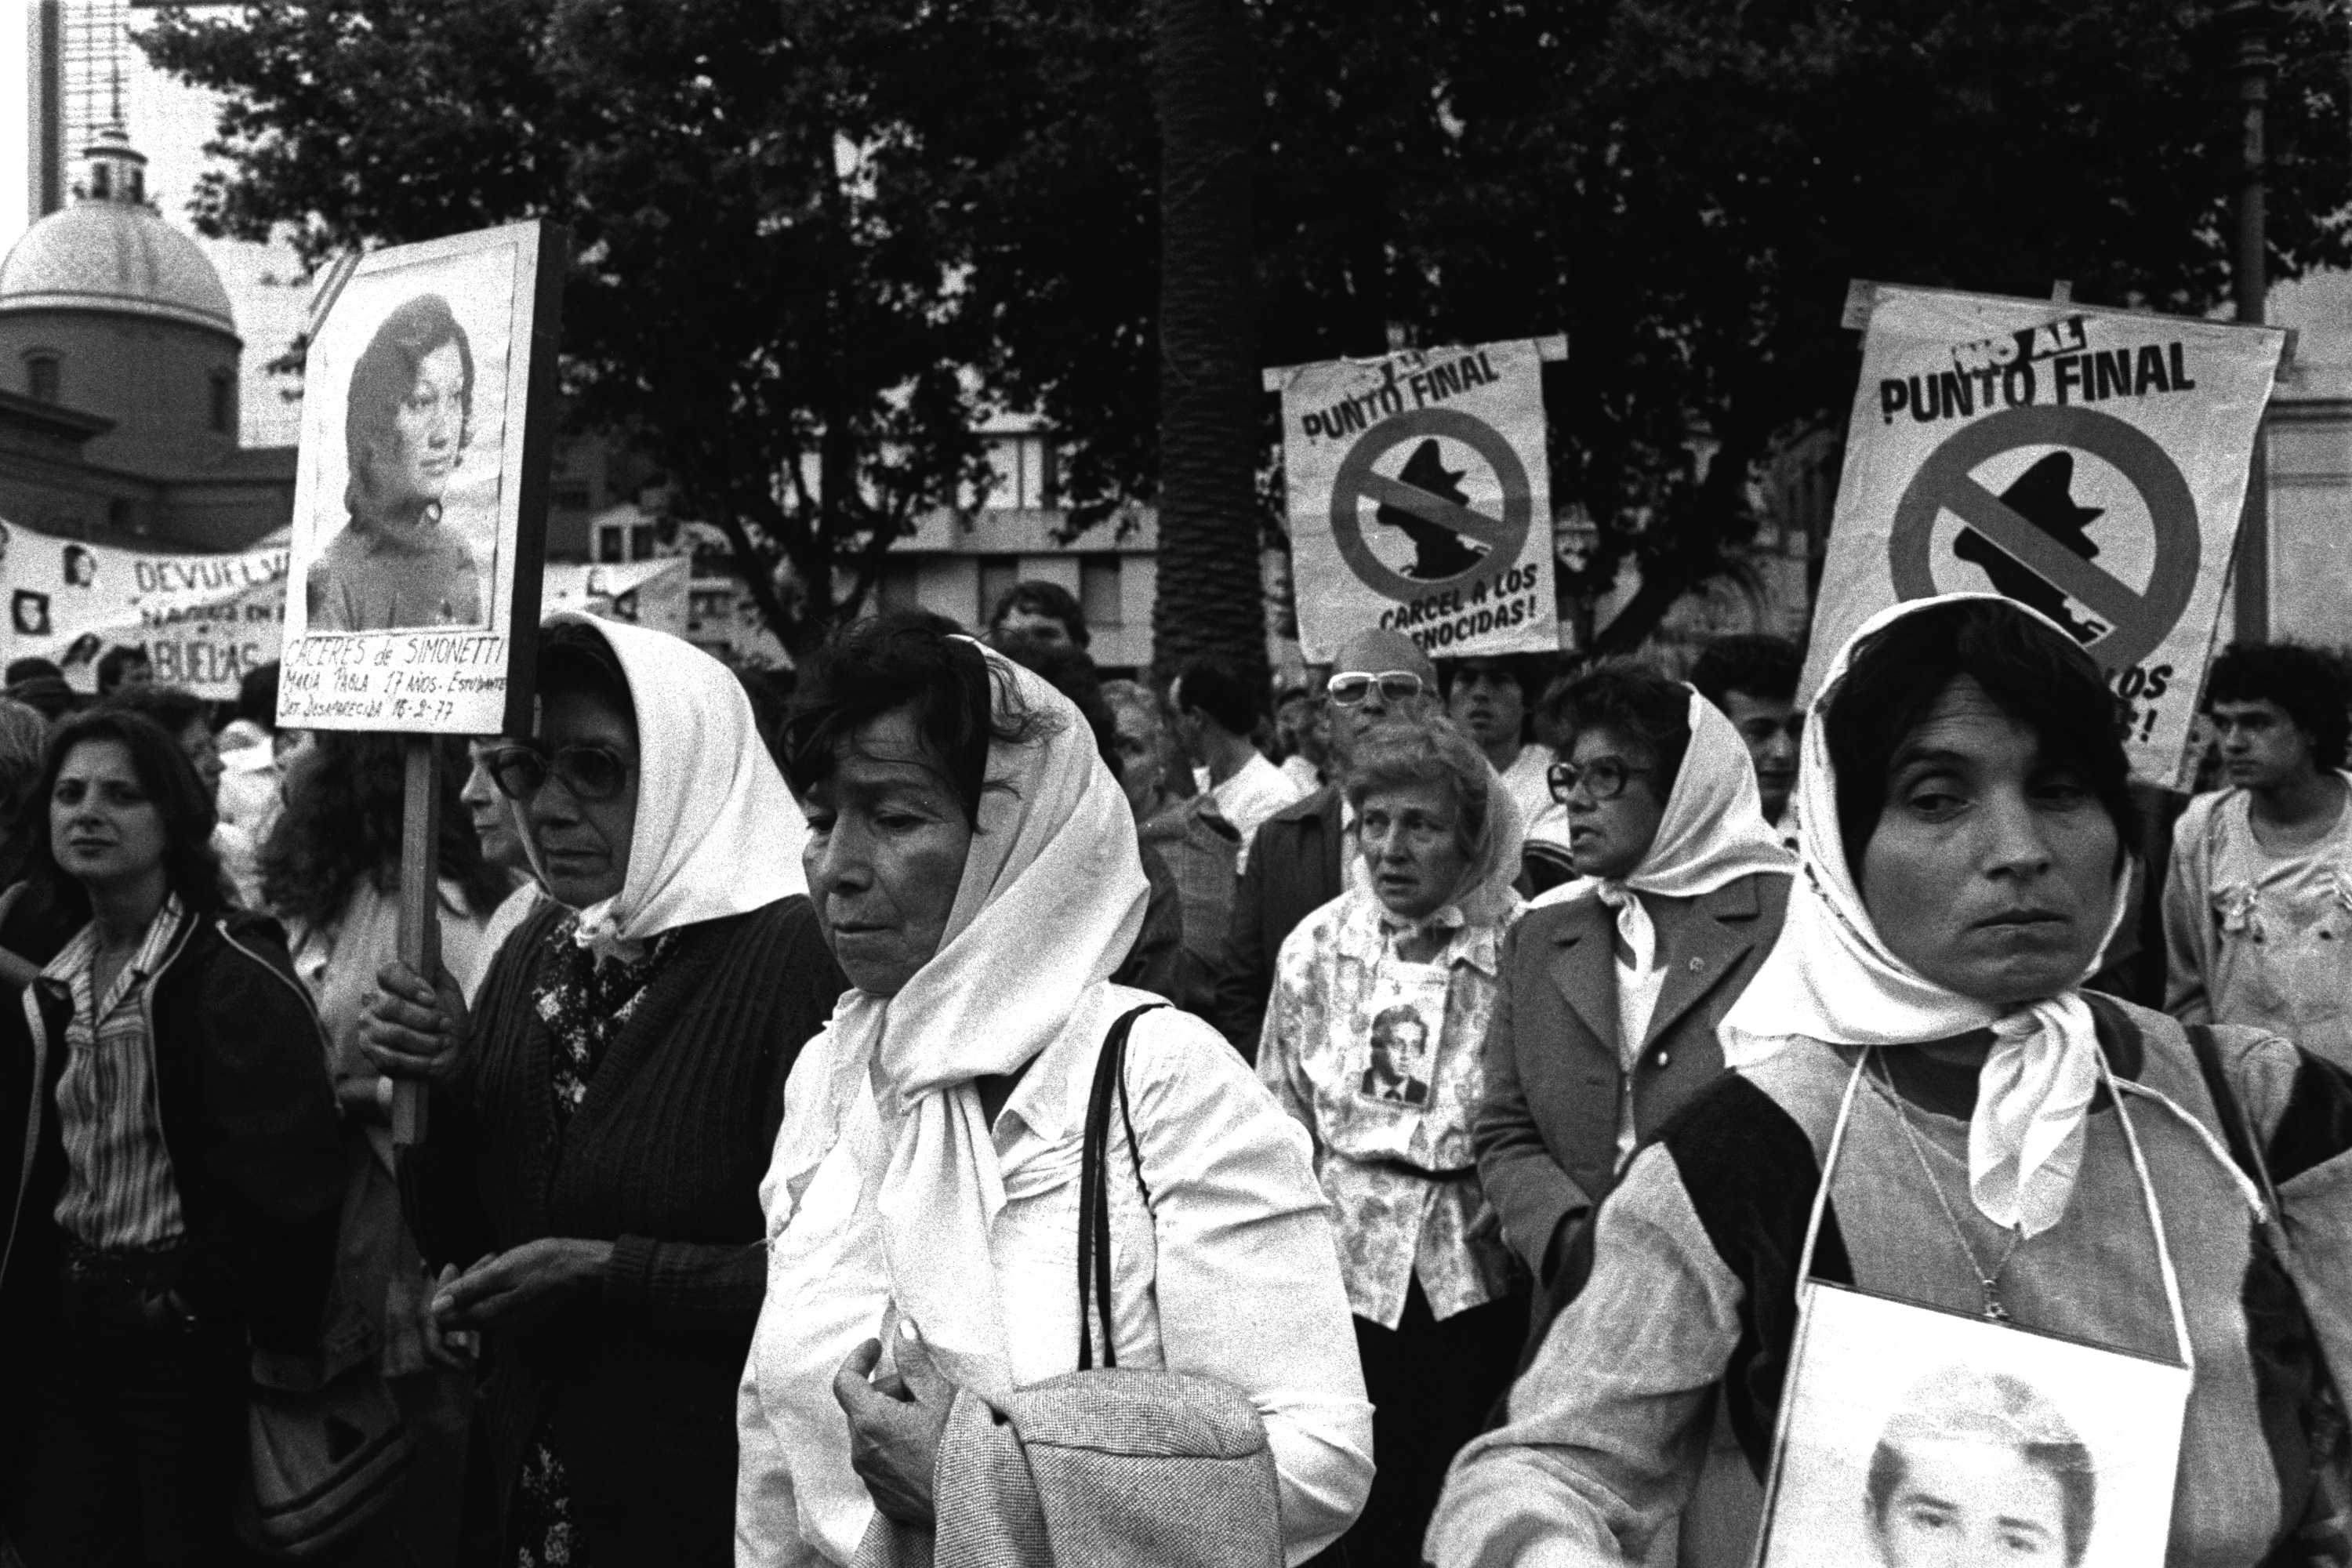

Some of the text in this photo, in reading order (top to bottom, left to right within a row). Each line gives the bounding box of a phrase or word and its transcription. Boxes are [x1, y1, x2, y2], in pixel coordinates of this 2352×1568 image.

[1301, 385, 1404, 445] PUNTO
[1410, 351, 1499, 409] FINAL
[1882, 343, 2195, 424] PUNTO FINAL
[1380, 563, 1537, 630] CARCEL A LOS
[1411, 594, 1536, 650] ENOCIDAS!
[374, 639, 394, 666] de
[404, 636, 506, 664] SIMONETTI
